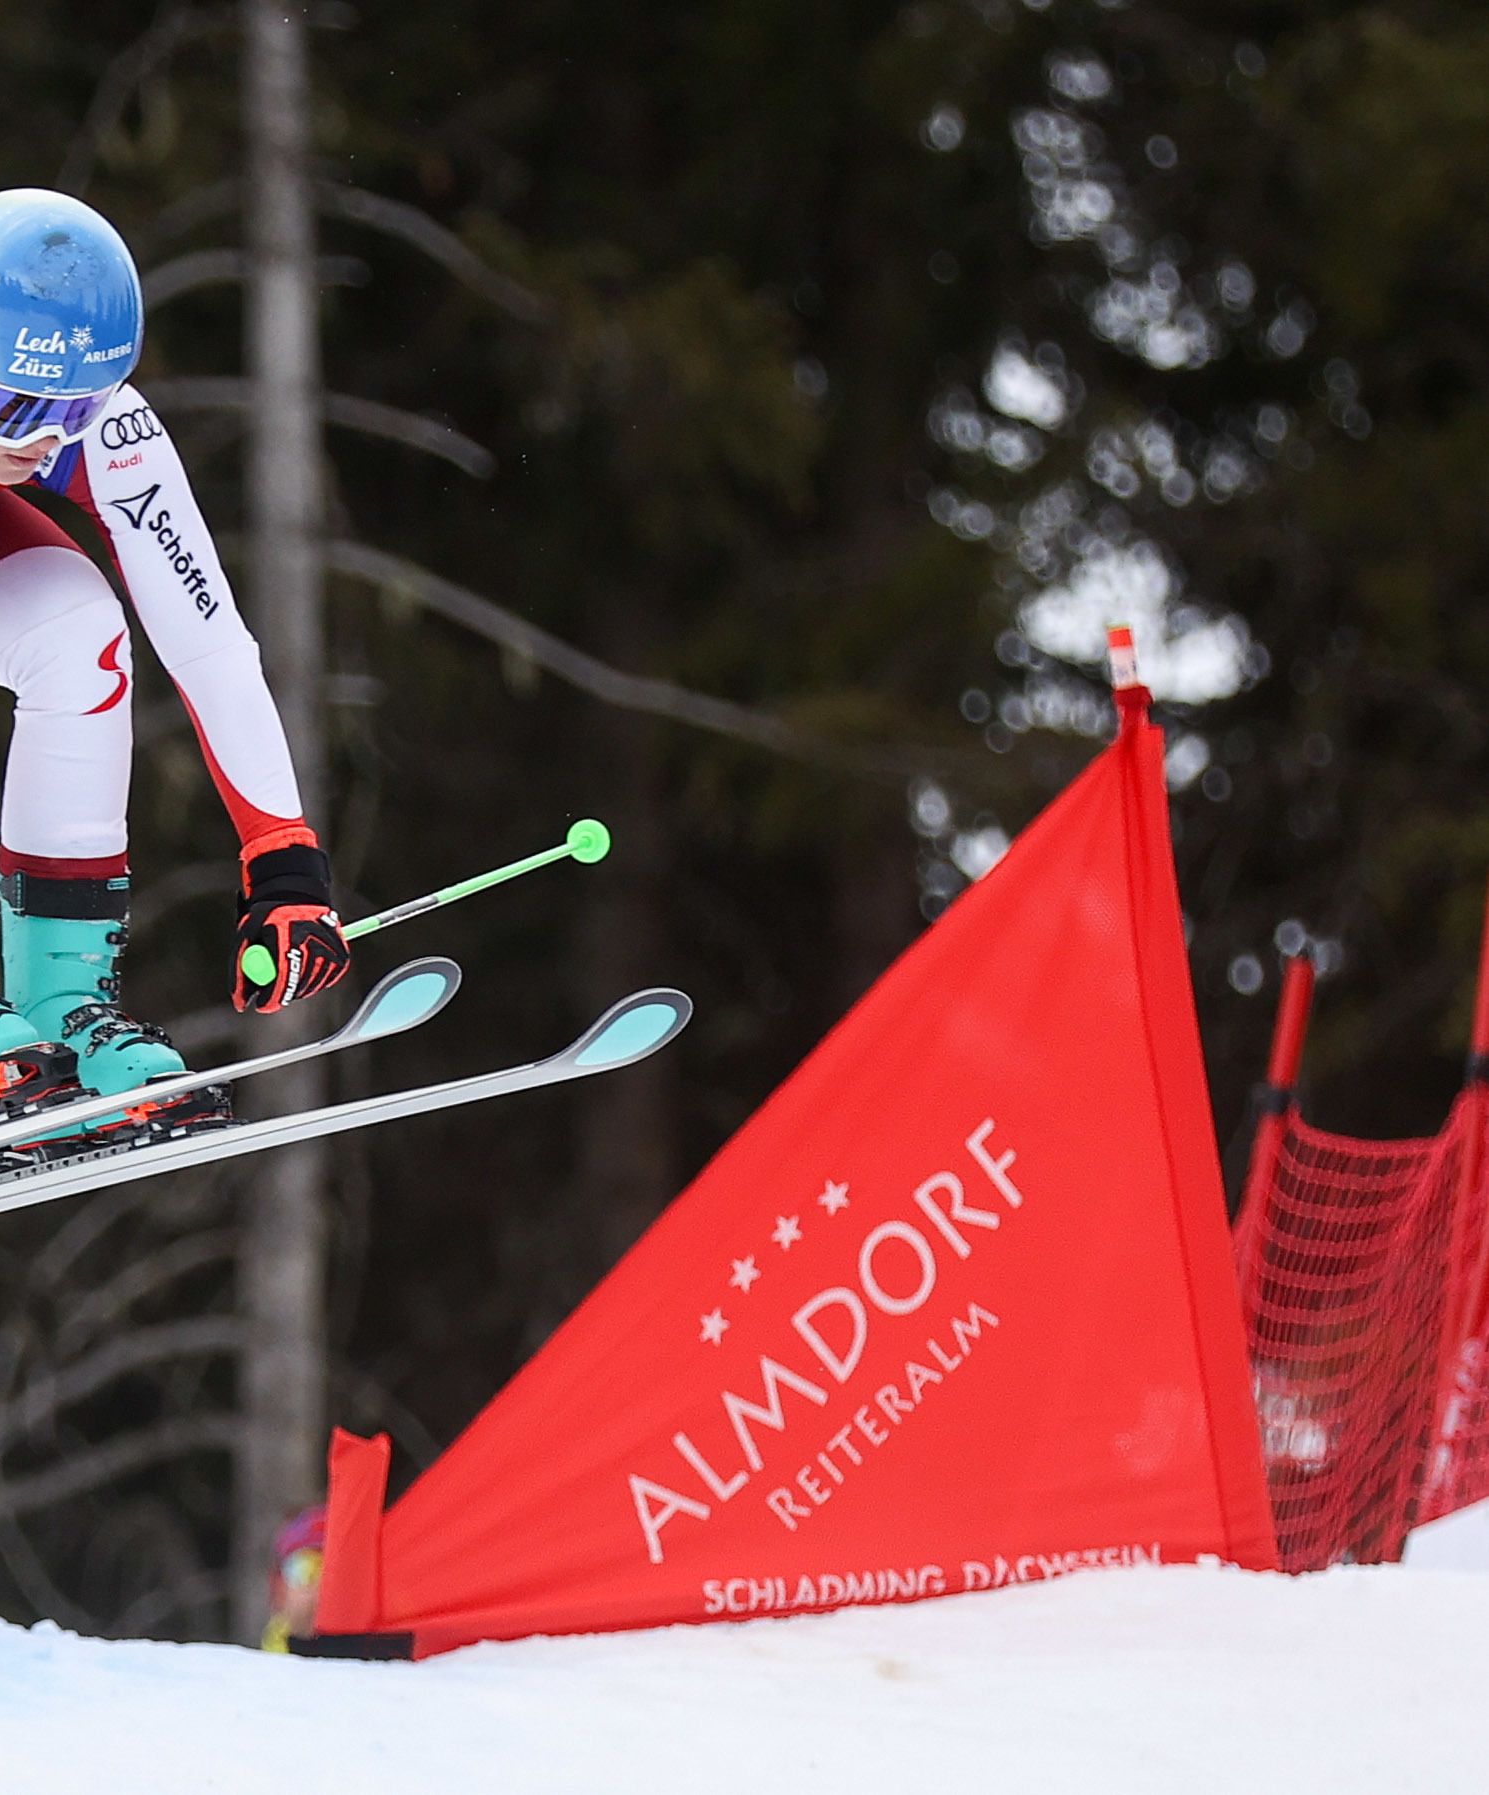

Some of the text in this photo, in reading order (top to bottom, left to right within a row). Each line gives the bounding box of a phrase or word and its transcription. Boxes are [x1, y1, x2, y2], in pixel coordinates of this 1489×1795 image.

[14, 327, 67, 355] Lech
[82, 341, 133, 364] ARLBERG
[8, 352, 64, 378] Zürs
[107, 452, 143, 471] Audi
[281, 948, 302, 1007] reusch
[626, 1117, 1024, 1565] ALMDORF
[765, 1301, 1001, 1532] REITERALM
[702, 1564, 947, 1614] SCHLADMING
